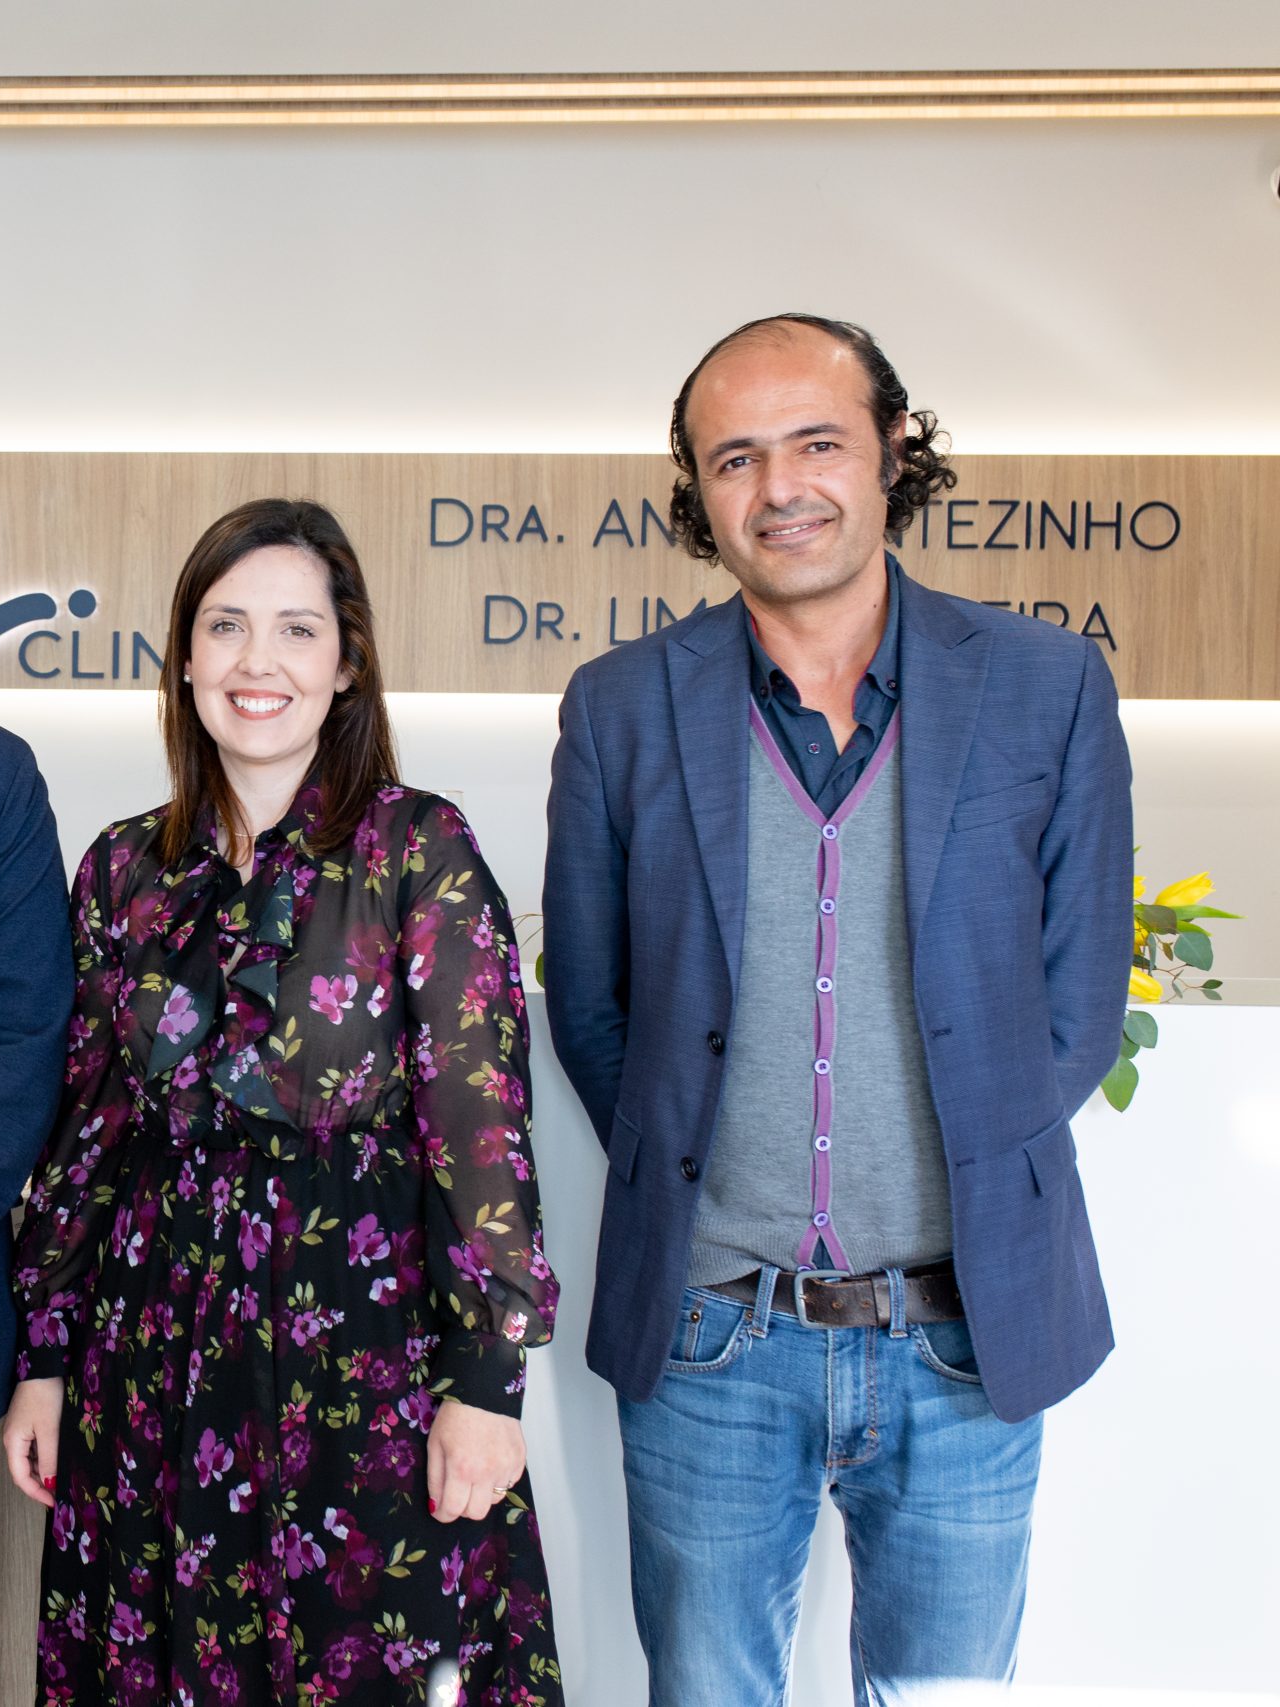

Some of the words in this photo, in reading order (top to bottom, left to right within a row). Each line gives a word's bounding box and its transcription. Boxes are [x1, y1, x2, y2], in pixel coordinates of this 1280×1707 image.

[592, 498, 677, 548] AN
[895, 500, 1181, 551] TEZINHO
[483, 595, 581, 645] DR.
[609, 597, 708, 646] LIM
[18, 630, 169, 679] CLIN
